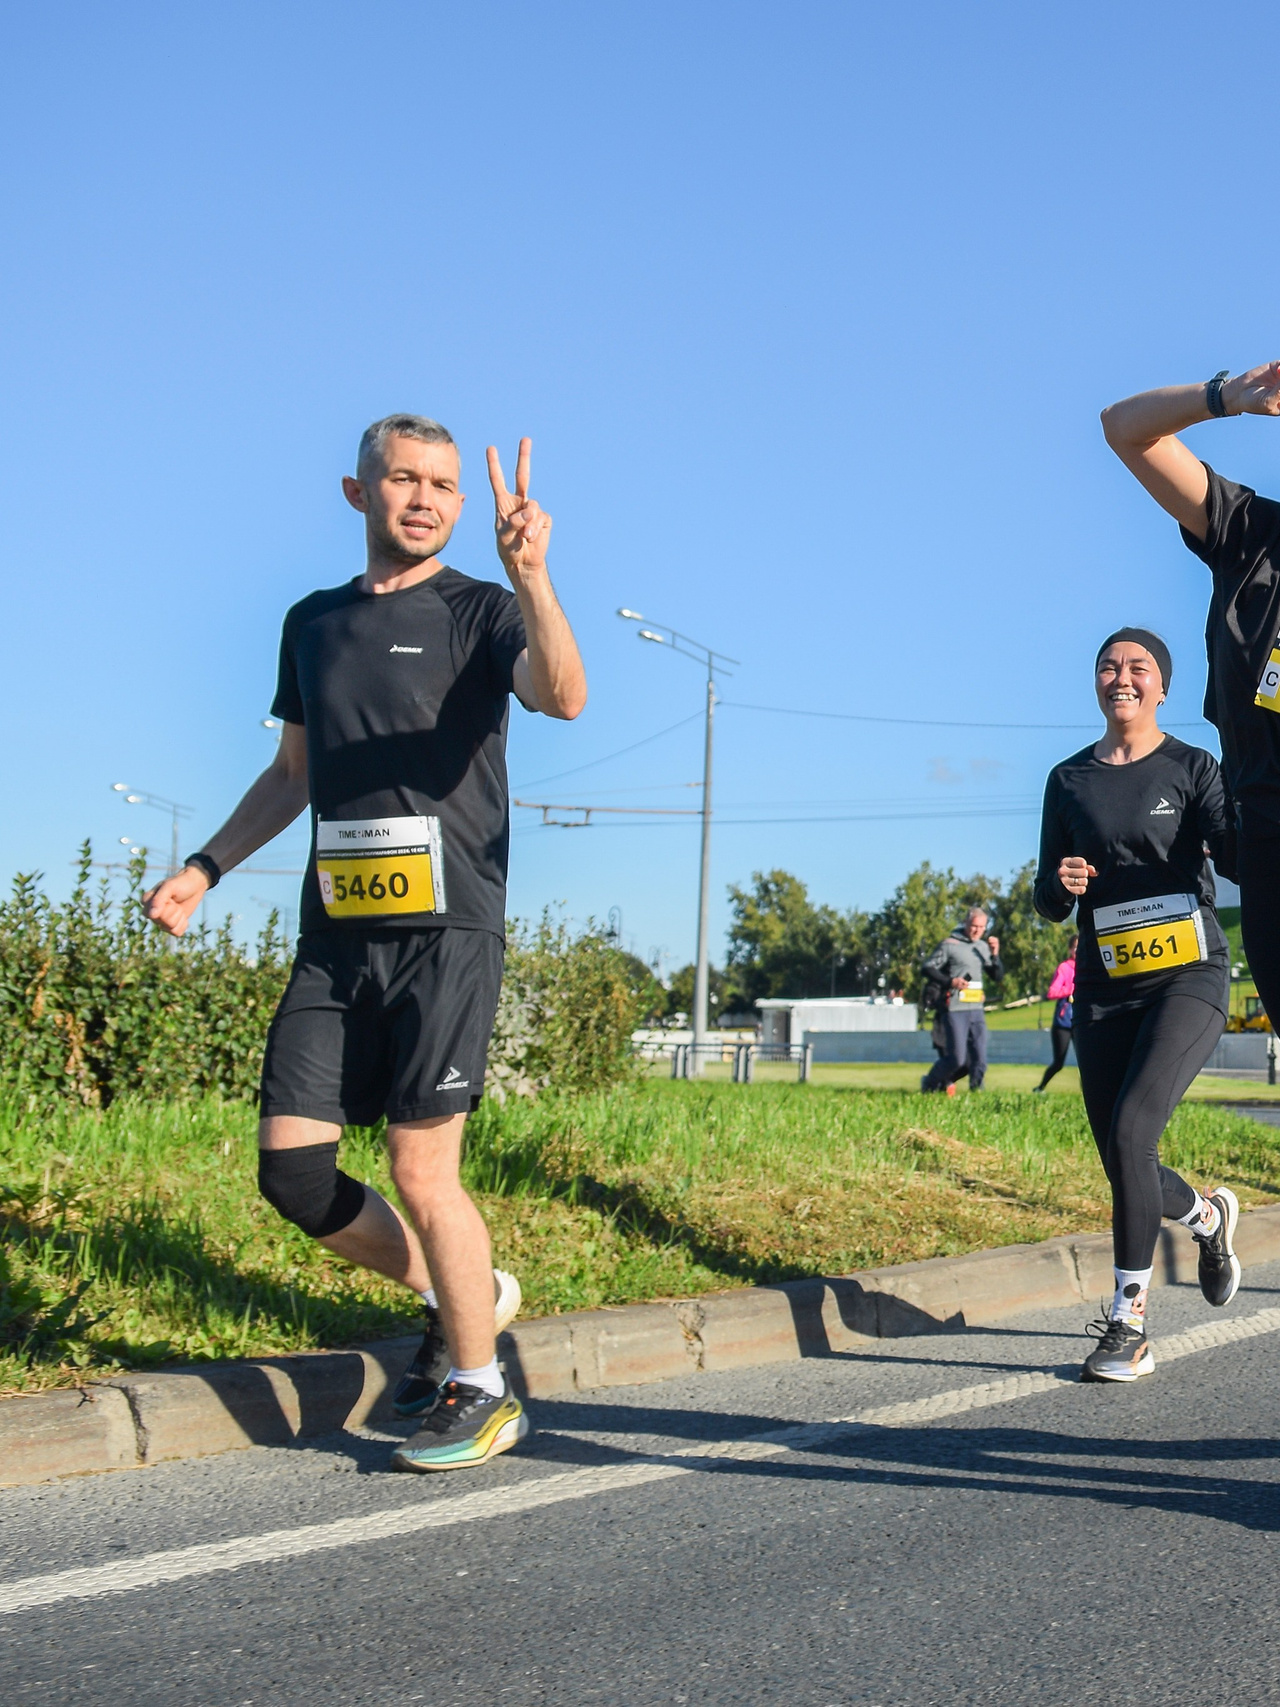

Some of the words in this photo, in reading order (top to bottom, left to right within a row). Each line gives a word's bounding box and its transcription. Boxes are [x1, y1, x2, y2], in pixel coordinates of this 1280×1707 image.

[334, 872, 409, 901] 5460
[1102, 950, 1112, 962] D
[1115, 935, 1179, 965] 5461
